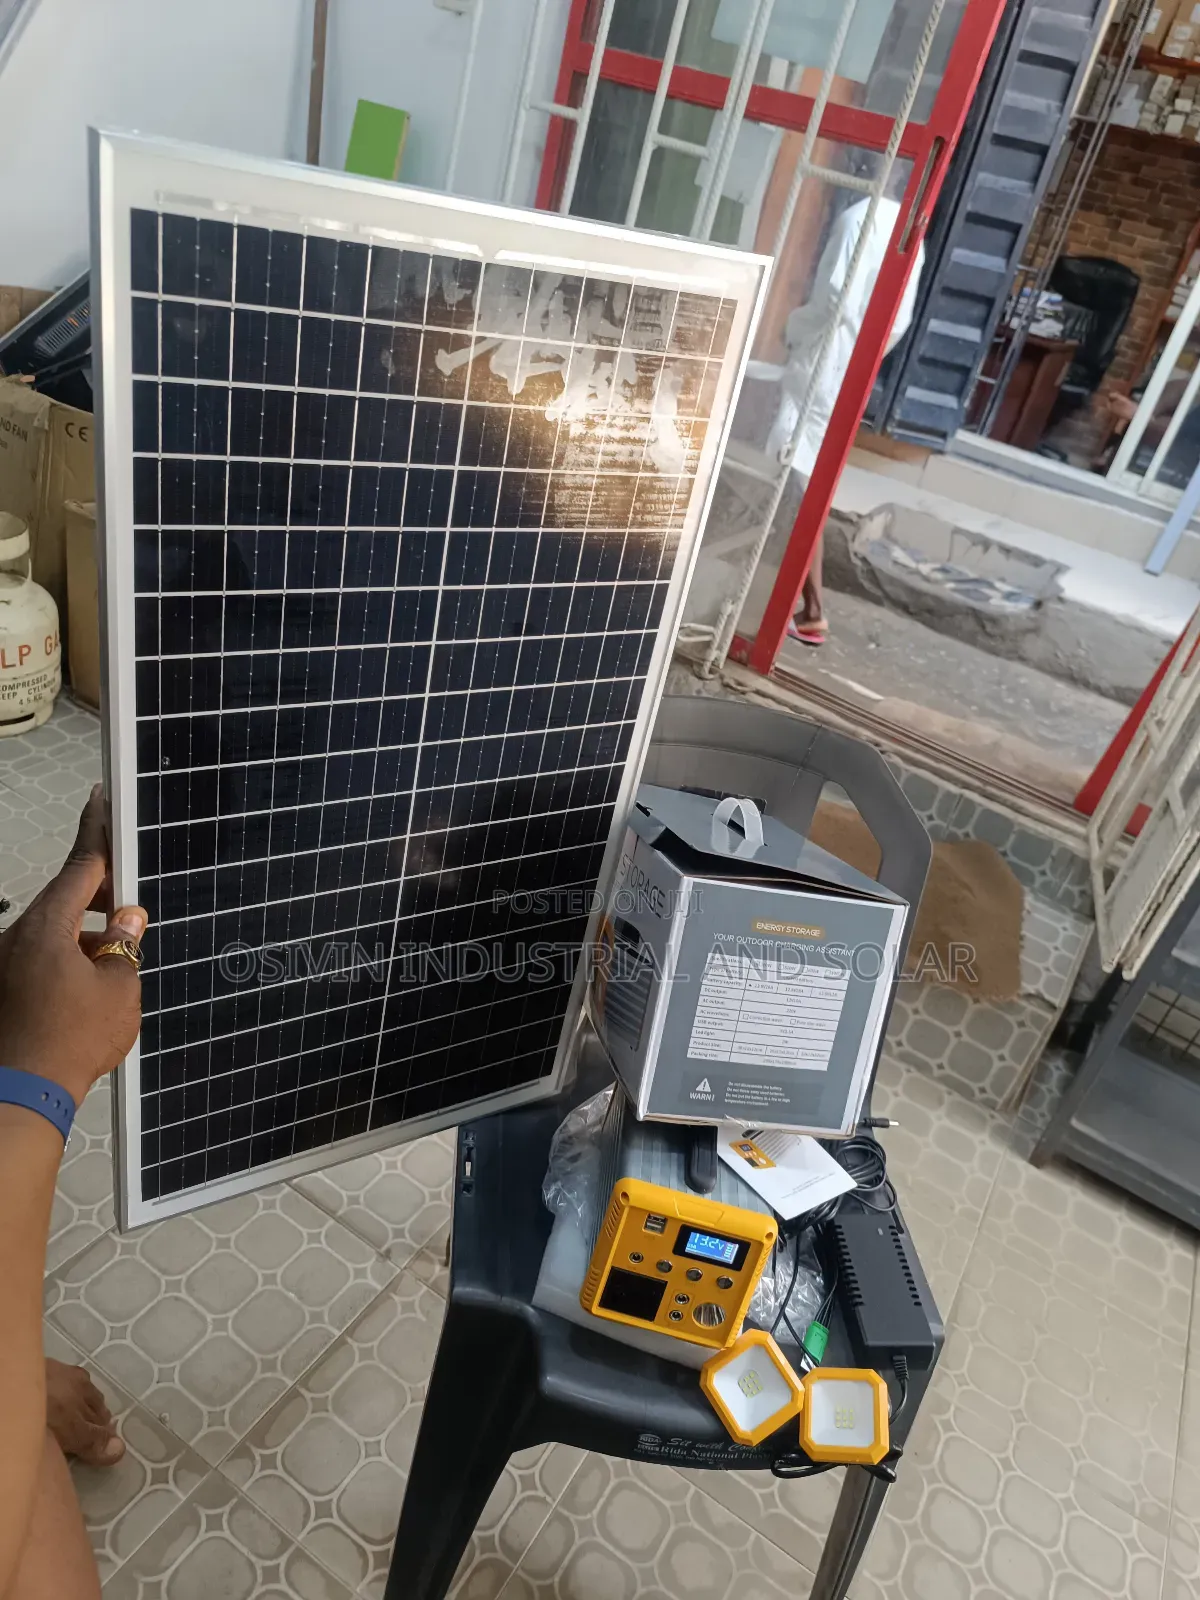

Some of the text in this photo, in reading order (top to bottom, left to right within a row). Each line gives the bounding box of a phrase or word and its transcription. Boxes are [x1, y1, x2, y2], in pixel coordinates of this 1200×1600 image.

[65, 422, 88, 442] CE
[1, 644, 31, 669] LP
[0, 674, 47, 692] OMPRESSED
[0, 692, 17, 700] EEP
[620, 853, 666, 919] STORAGE
[756, 922, 821, 937] ENERGY STORAGE
[713, 932, 856, 957] YOUR OUTDOOR CHARGING ASSISTANT
